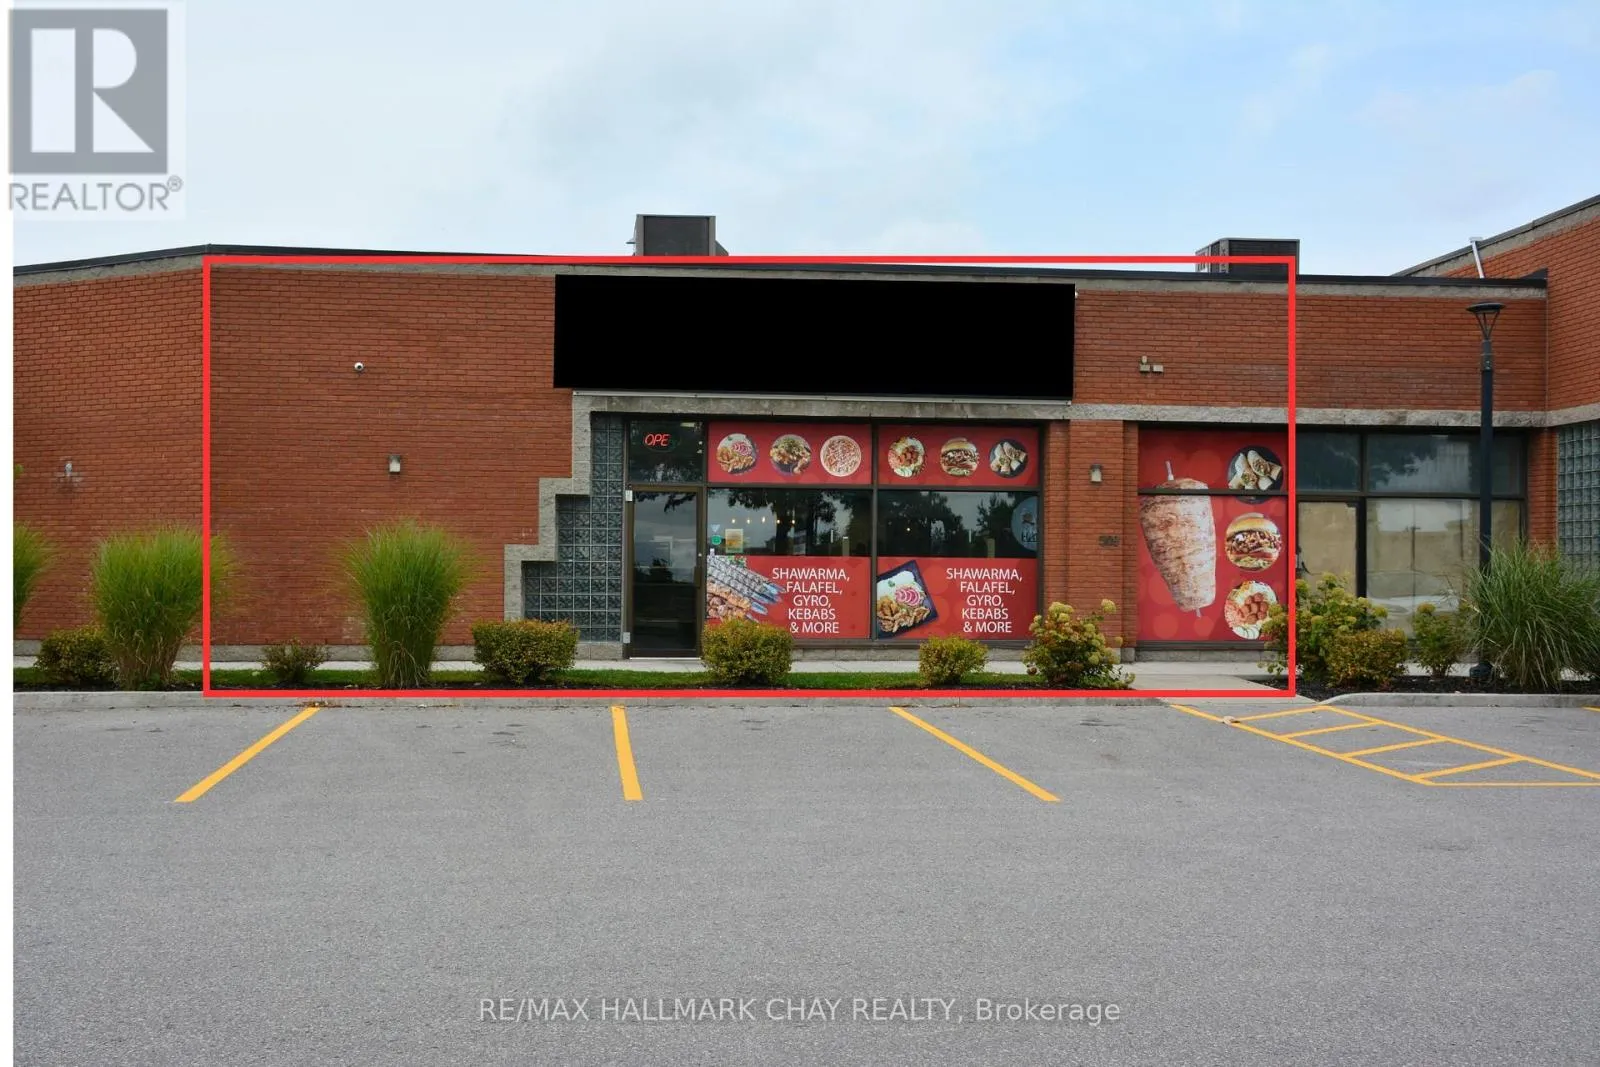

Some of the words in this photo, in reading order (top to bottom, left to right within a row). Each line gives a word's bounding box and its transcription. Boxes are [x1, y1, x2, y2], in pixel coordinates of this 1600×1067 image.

[644, 433, 674, 447] OPE
[772, 567, 850, 582] SHAWARMA,
[946, 567, 1023, 582] SHAWARMA,
[786, 581, 843, 595] FALAFEL,
[960, 581, 1015, 595] FALAFEL,
[793, 594, 831, 608] GYRO,
[966, 594, 1004, 608] GYRO,
[788, 608, 836, 620] KEBABS
[961, 607, 1009, 620] KEBABS
[790, 621, 799, 633] &
[802, 621, 840, 634] MORE
[963, 621, 972, 633] &
[975, 621, 1013, 633] MORE
